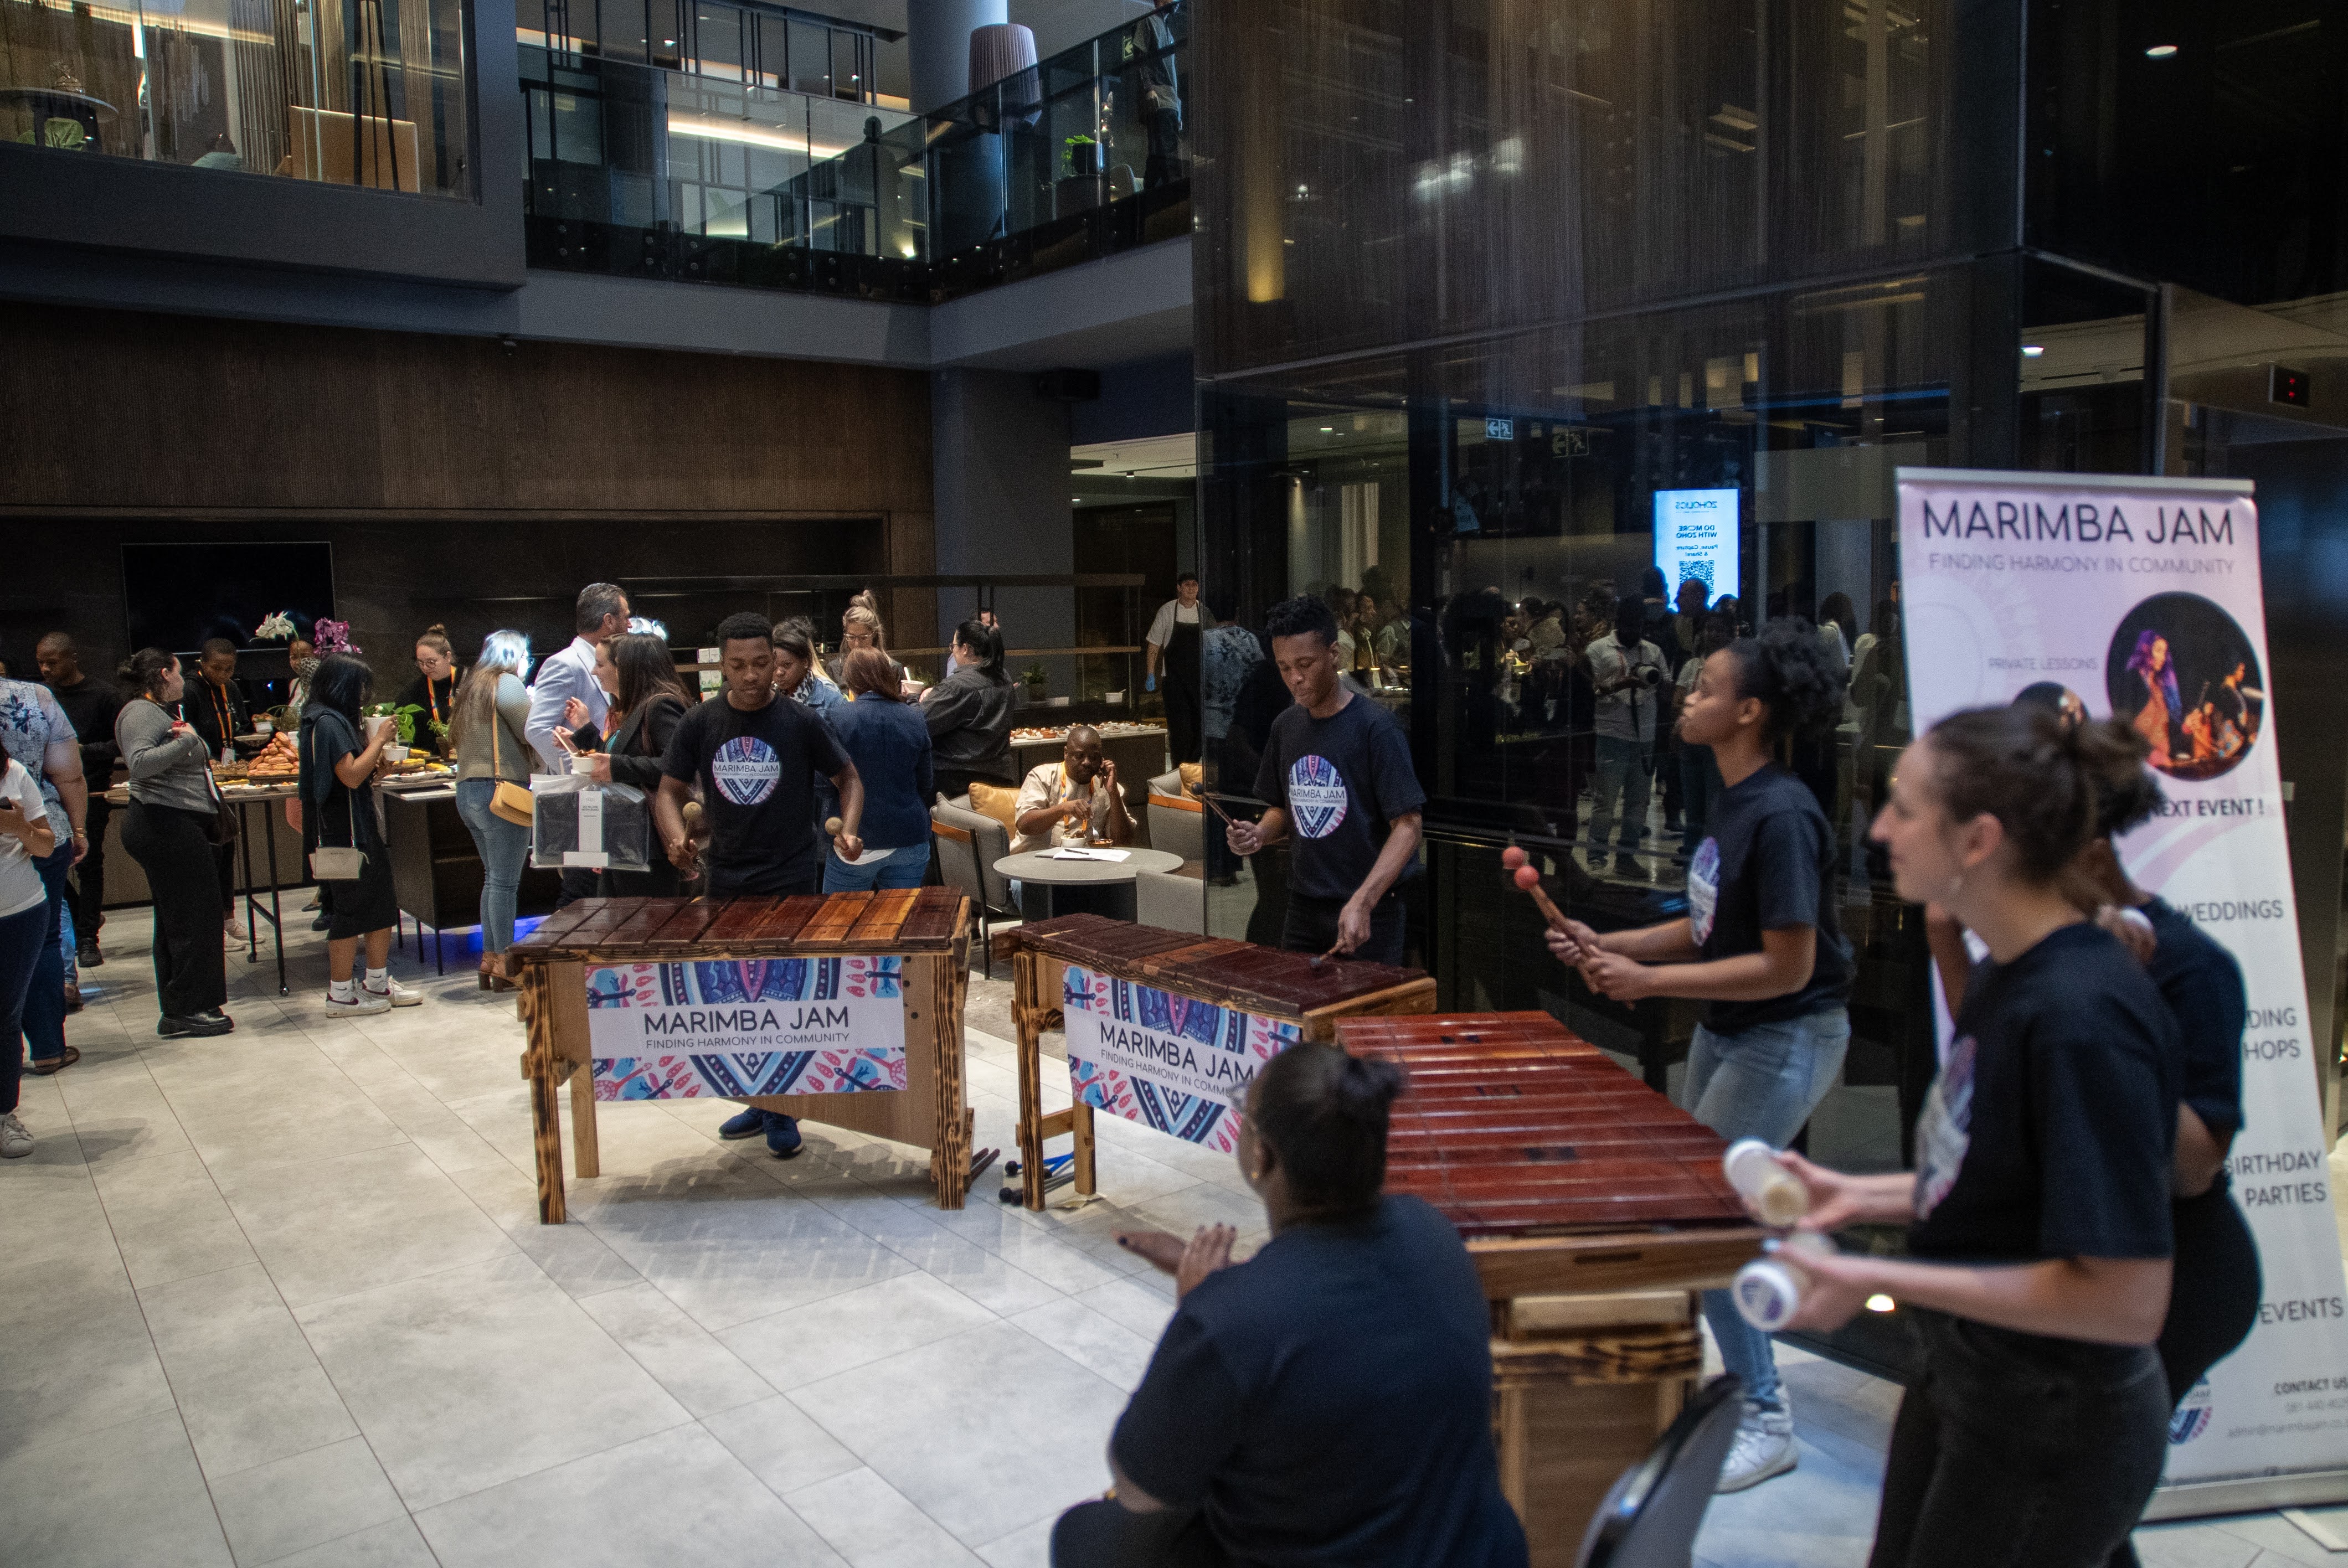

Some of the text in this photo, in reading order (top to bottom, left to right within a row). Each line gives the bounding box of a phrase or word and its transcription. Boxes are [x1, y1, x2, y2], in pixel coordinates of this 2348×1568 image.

[1923, 500, 2234, 545] MARIMBA JAM
[1930, 553, 2234, 575] FINDING HARMONY IN COMMUNITY
[1324, 790, 1345, 798] JAM
[2197, 798, 2253, 817] EVENT
[644, 1006, 849, 1035] MARIMBA JAM
[2245, 1008, 2297, 1030] DING
[646, 1033, 849, 1050] FINDING HARMONY IN COMMUNITY
[2242, 1039, 2301, 1060] HOPS
[1100, 1022, 1254, 1084] MARIMBA JAM
[1101, 1049, 1134, 1068] FINDING
[1135, 1061, 1179, 1082] HARMONY
[1182, 1074, 1191, 1086] IN
[2245, 1182, 2326, 1206] PARTIES
[2259, 1297, 2344, 1325] EVENTS
[2274, 1378, 2329, 1396] CONTACT
